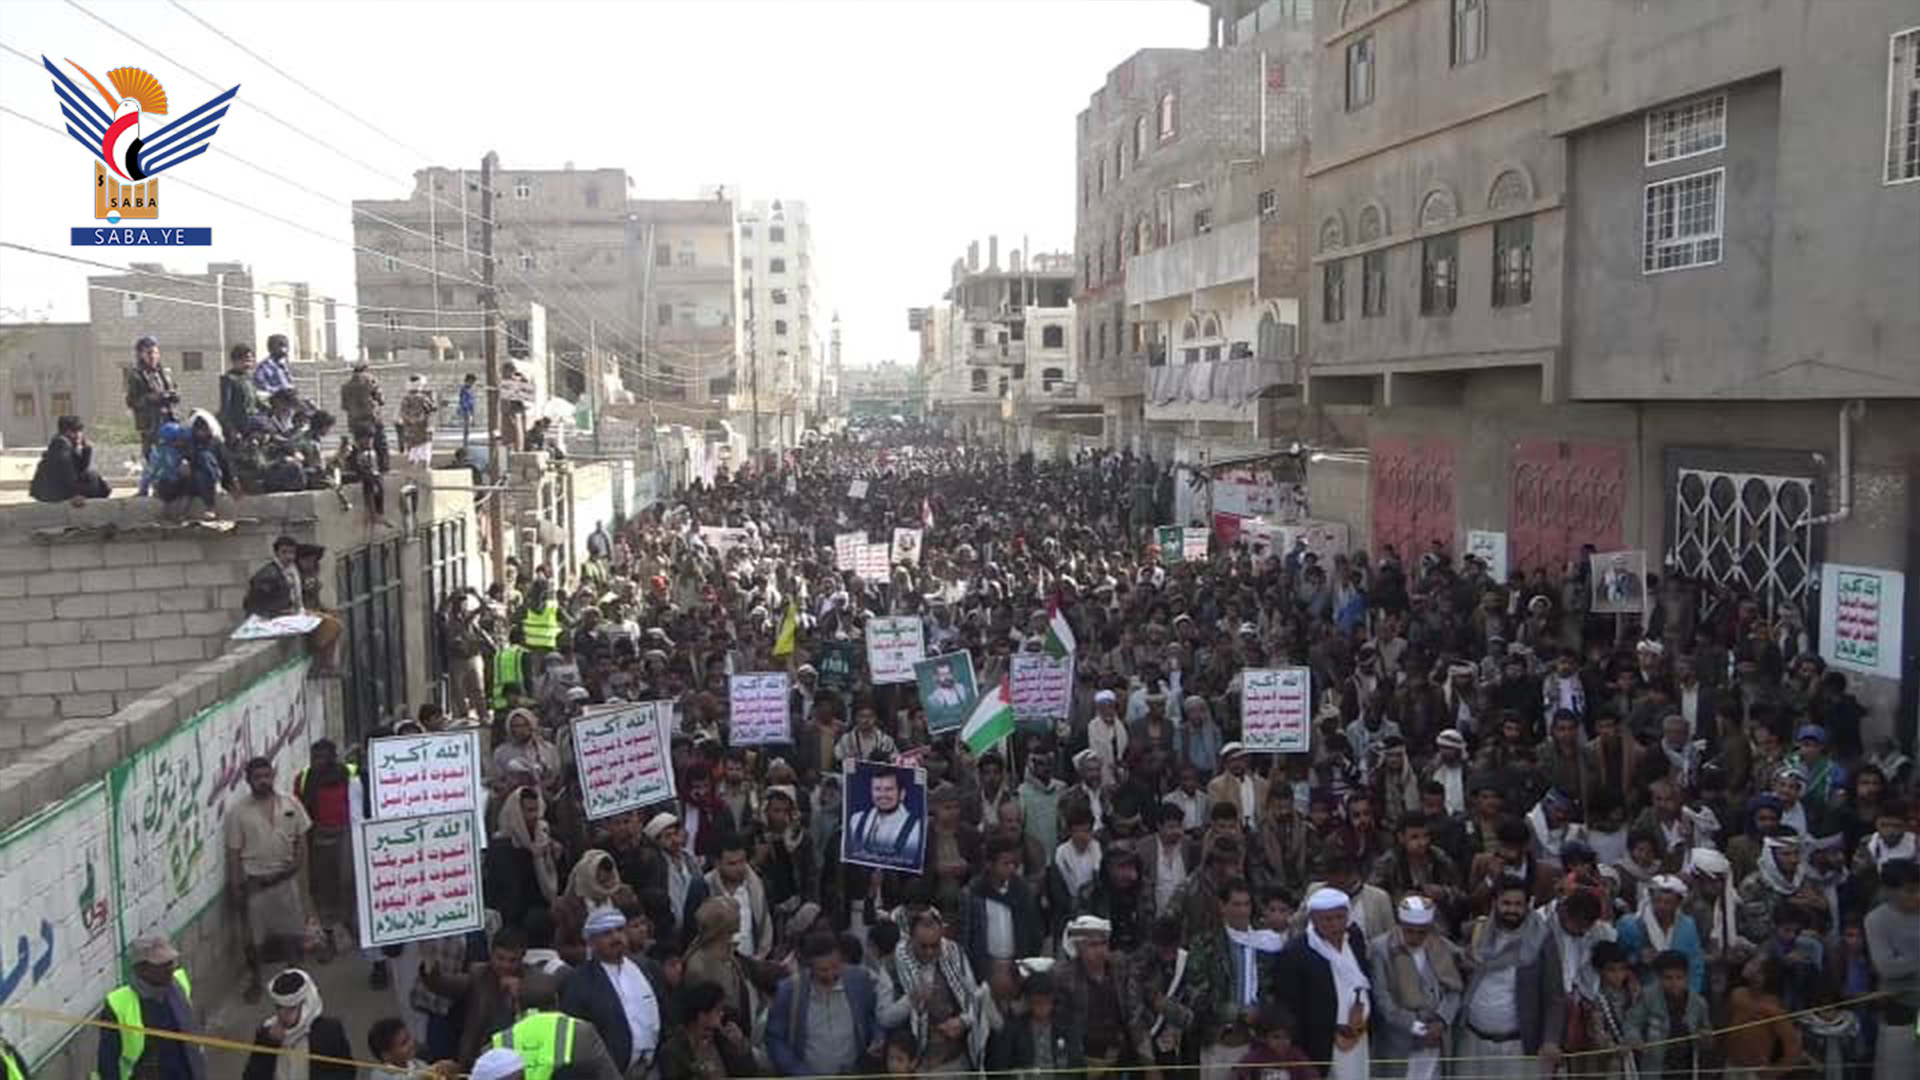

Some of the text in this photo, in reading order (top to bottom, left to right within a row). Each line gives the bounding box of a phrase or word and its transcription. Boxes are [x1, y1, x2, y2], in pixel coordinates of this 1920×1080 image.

[583, 710, 653, 744] الله أكبر
[379, 741, 468, 770] الله أكبر
[430, 765, 469, 782] الموت
[371, 818, 469, 852] الله أكبر
[428, 842, 470, 862] الموت
[429, 864, 471, 882] الموت
[431, 902, 474, 929] النصر
